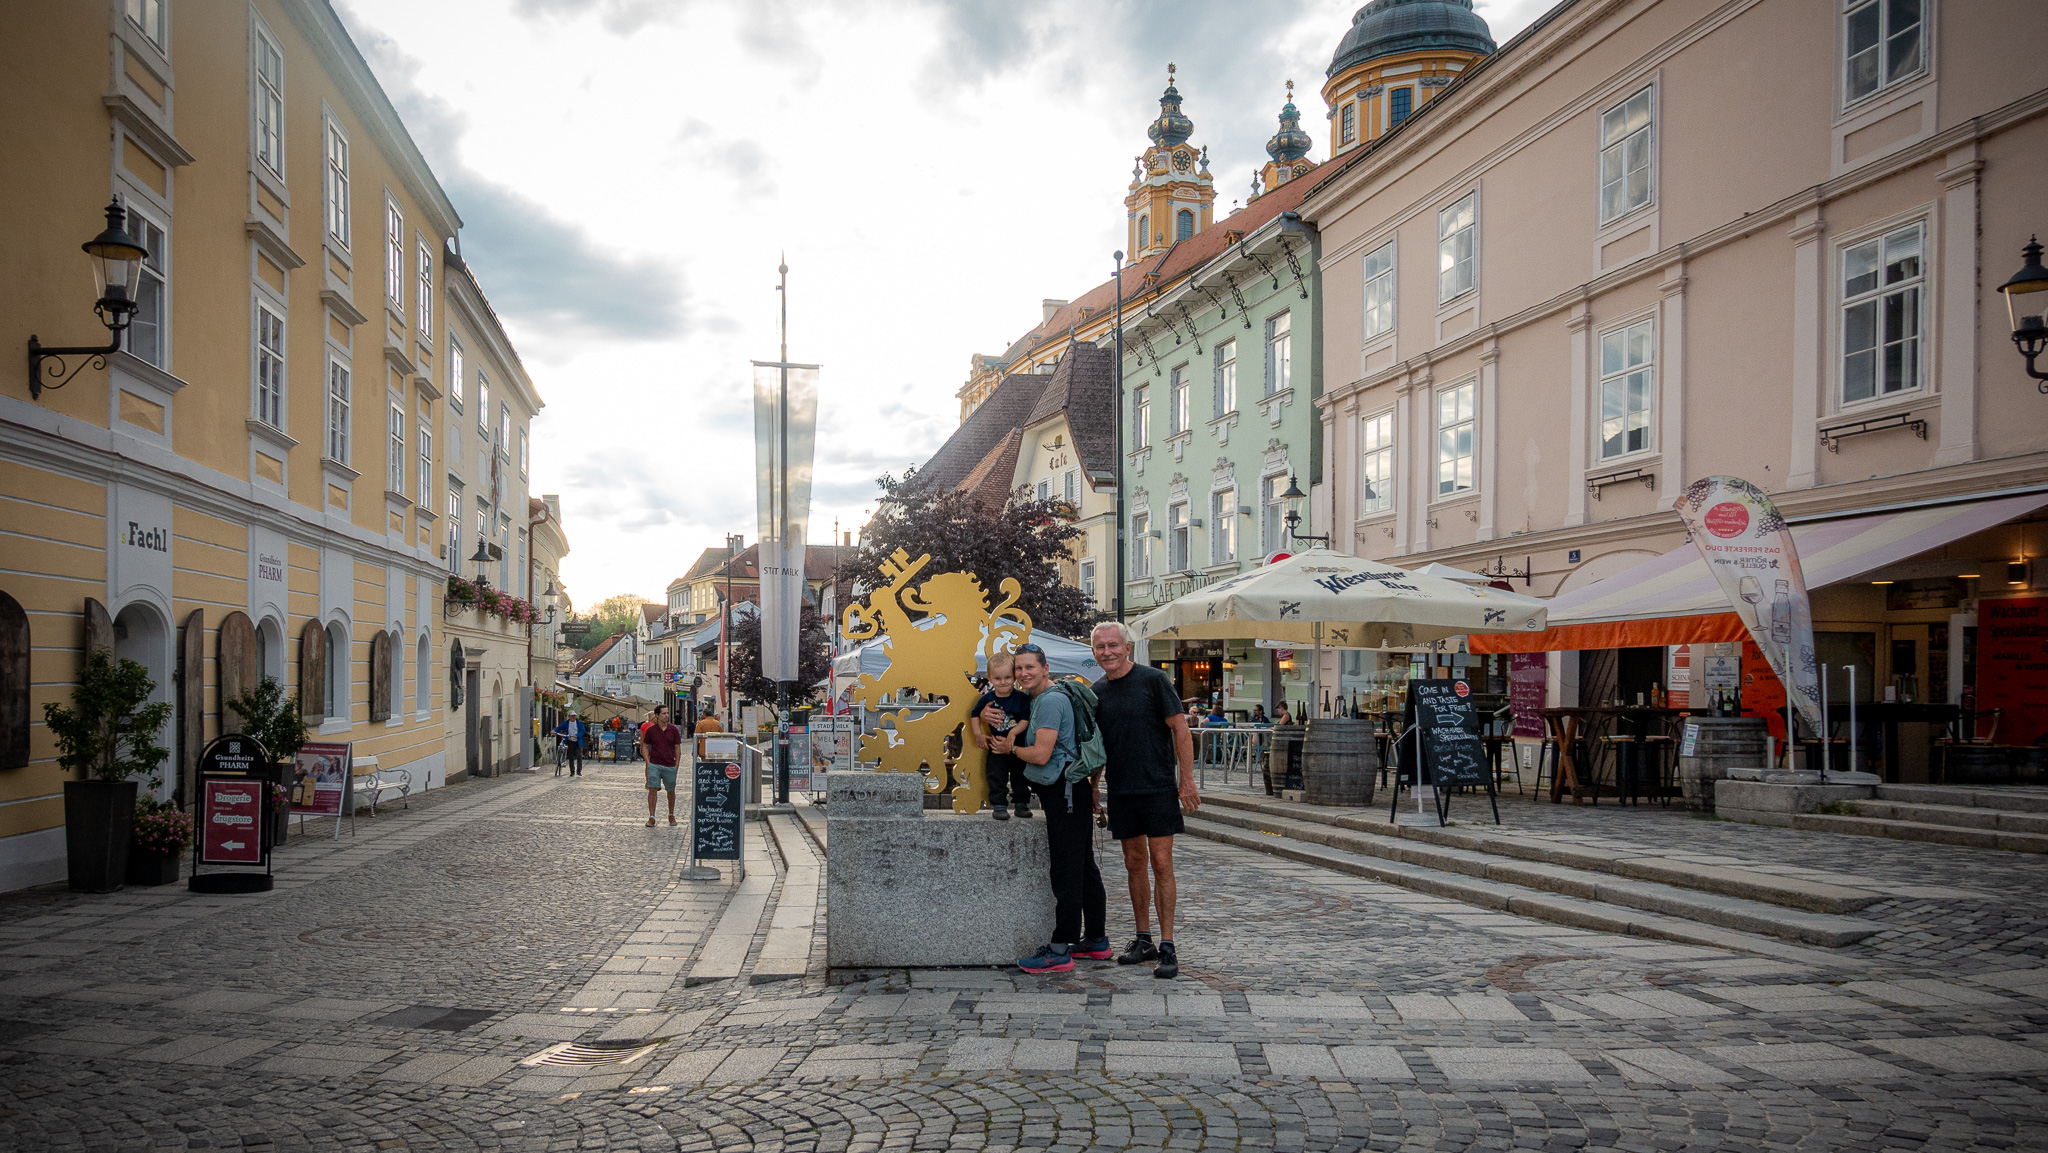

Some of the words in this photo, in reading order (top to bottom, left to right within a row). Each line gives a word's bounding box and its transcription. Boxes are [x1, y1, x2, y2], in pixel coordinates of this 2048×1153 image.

[129, 521, 167, 553] Fachl
[259, 564, 282, 582] PHARM
[1313, 571, 1407, 595] Wieselburger
[1379, 580, 1421, 591] Bier
[1990, 604, 2040, 618] Wachauer
[1436, 696, 1458, 704] TASTE
[700, 784, 710, 793] for
[216, 793, 251, 804] Drogerie
[831, 790, 877, 801] STADT
[214, 813, 252, 824] drugstore
